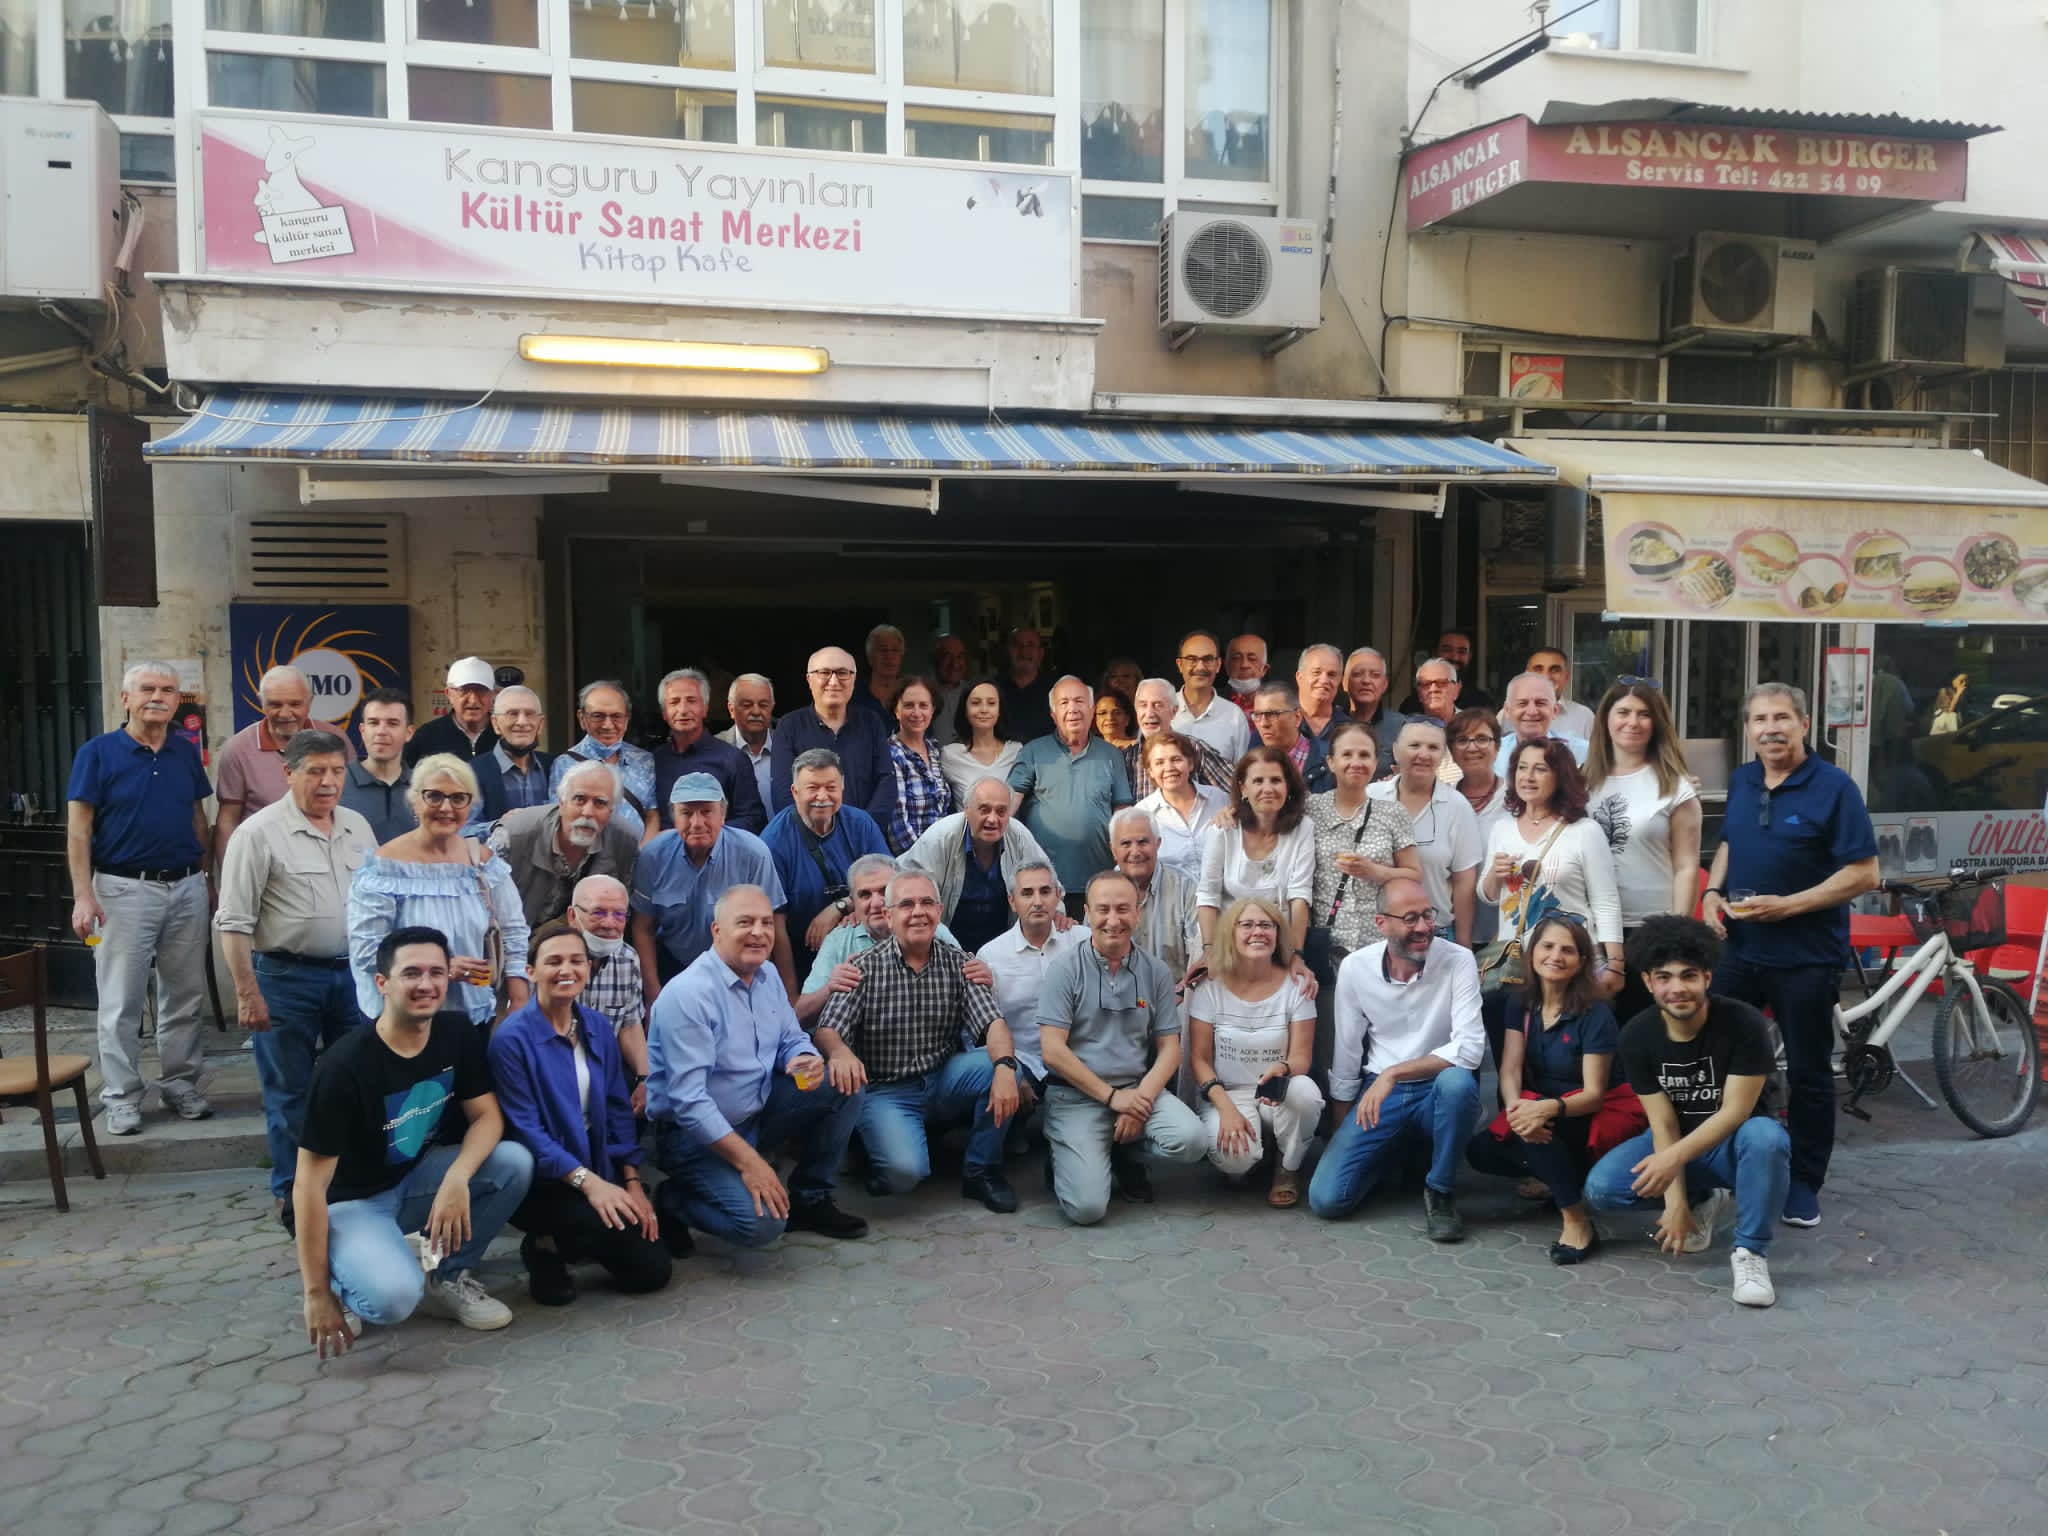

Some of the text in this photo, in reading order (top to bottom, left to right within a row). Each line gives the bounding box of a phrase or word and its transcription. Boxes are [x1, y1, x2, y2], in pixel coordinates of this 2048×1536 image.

[1410, 132, 1501, 200] ALSANCAK
[1566, 125, 1938, 172] ALSANCAK BURGER
[444, 147, 873, 209] Kanguru Yayınları
[1451, 159, 1521, 211] BURGER
[1626, 159, 1882, 193] Servis Tel: 422 54 09
[273, 226, 343, 244] kültür sanat
[279, 214, 329, 227] kanguru
[461, 191, 862, 252] Kültür Sanat Merkezi
[288, 242, 335, 256] merkezi
[578, 241, 753, 284] Kitap Kafe
[306, 674, 351, 696] MO
[1950, 858, 1987, 868] LOSTRA
